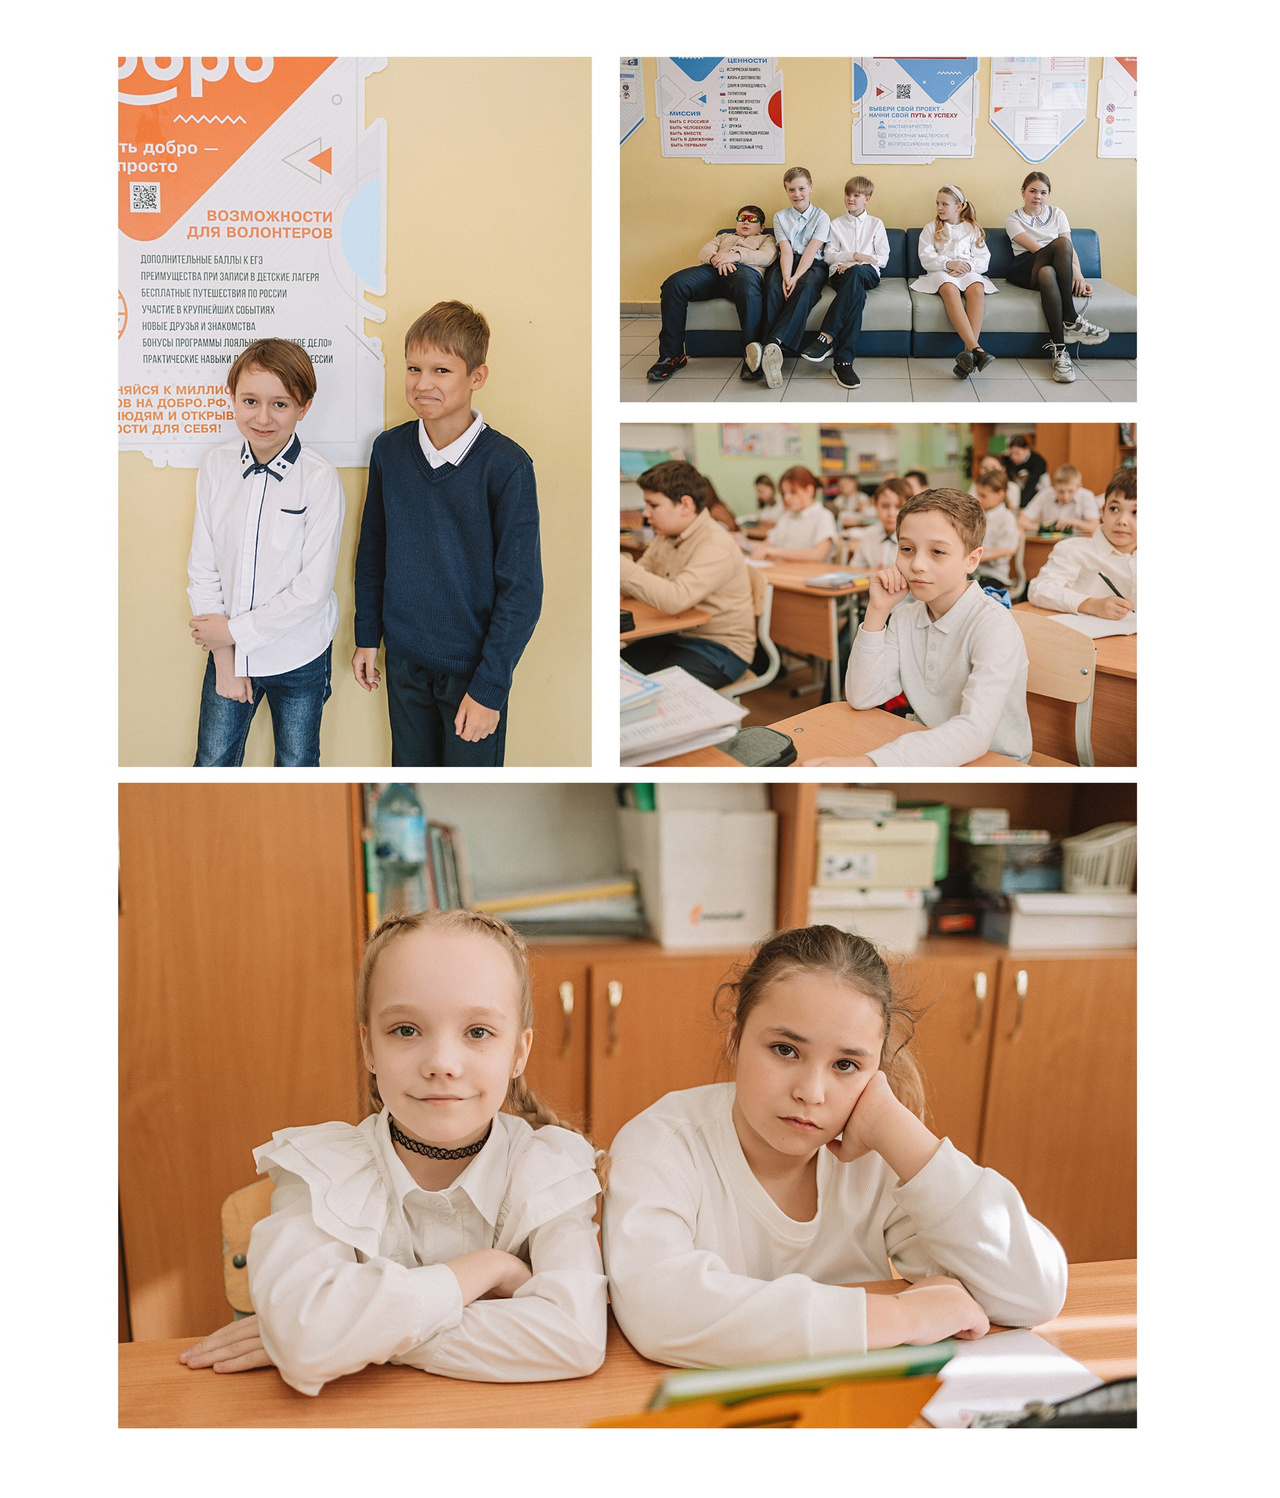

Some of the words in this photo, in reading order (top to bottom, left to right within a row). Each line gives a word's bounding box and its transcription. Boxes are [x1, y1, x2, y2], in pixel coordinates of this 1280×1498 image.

[143, 140, 198, 157] добро
[118, 161, 178, 174] просто
[207, 210, 333, 223] ВОЗМОЖНОСТИ
[187, 227, 221, 239] ДЛЯ
[226, 227, 333, 239] ВОЛОНТЕРОВ
[140, 255, 212, 265] ДОПОЛНИТЕЛЬНЫЕ
[214, 255, 242, 265] БАЛЛЫ
[243, 256, 249, 265] К
[250, 256, 263, 265] ЕГЭ
[141, 272, 201, 282] ПРЕИМУЩЕСТВА
[204, 272, 218, 281] ПРИ
[220, 272, 249, 282] ЗАПИСИ
[250, 273, 256, 282] В
[257, 273, 290, 282] ДЕТСКИЕ
[291, 273, 320, 282] ЛАГЕРЯ
[141, 288, 191, 298] БЕСПЛАТНЫЕ
[193, 289, 246, 298] ПУТЕШЕСТВИЯ
[248, 289, 258, 298] ПО
[259, 289, 287, 298] РОССИИ
[142, 305, 175, 314] УЧАСТИЕ
[177, 305, 182, 314] В
[183, 304, 234, 315] КРУПНЕЙШИХ
[236, 305, 275, 315] СОБЫТИЯХ
[142, 322, 168, 331] НОВЫЕ
[169, 322, 199, 332] ДРУЗЬЯ
[201, 322, 206, 331] И
[207, 322, 256, 331] ЗНАКОМСТВА
[142, 338, 174, 348] БОНУСЫ
[175, 338, 222, 348] ПРОГРАММЫ
[143, 354, 199, 364] ПРАКТИЧЕСКИЕ
[200, 354, 232, 364] НАВЫКИ
[163, 386, 172, 395] К
[136, 399, 153, 408] НА
[157, 398, 231, 409] ДОБРО.РФ,
[118, 412, 163, 422] ЮДЯМ
[168, 412, 177, 420] И
[152, 424, 180, 435] ДЛЯ
[184, 424, 221, 434] СЕБЯ!
